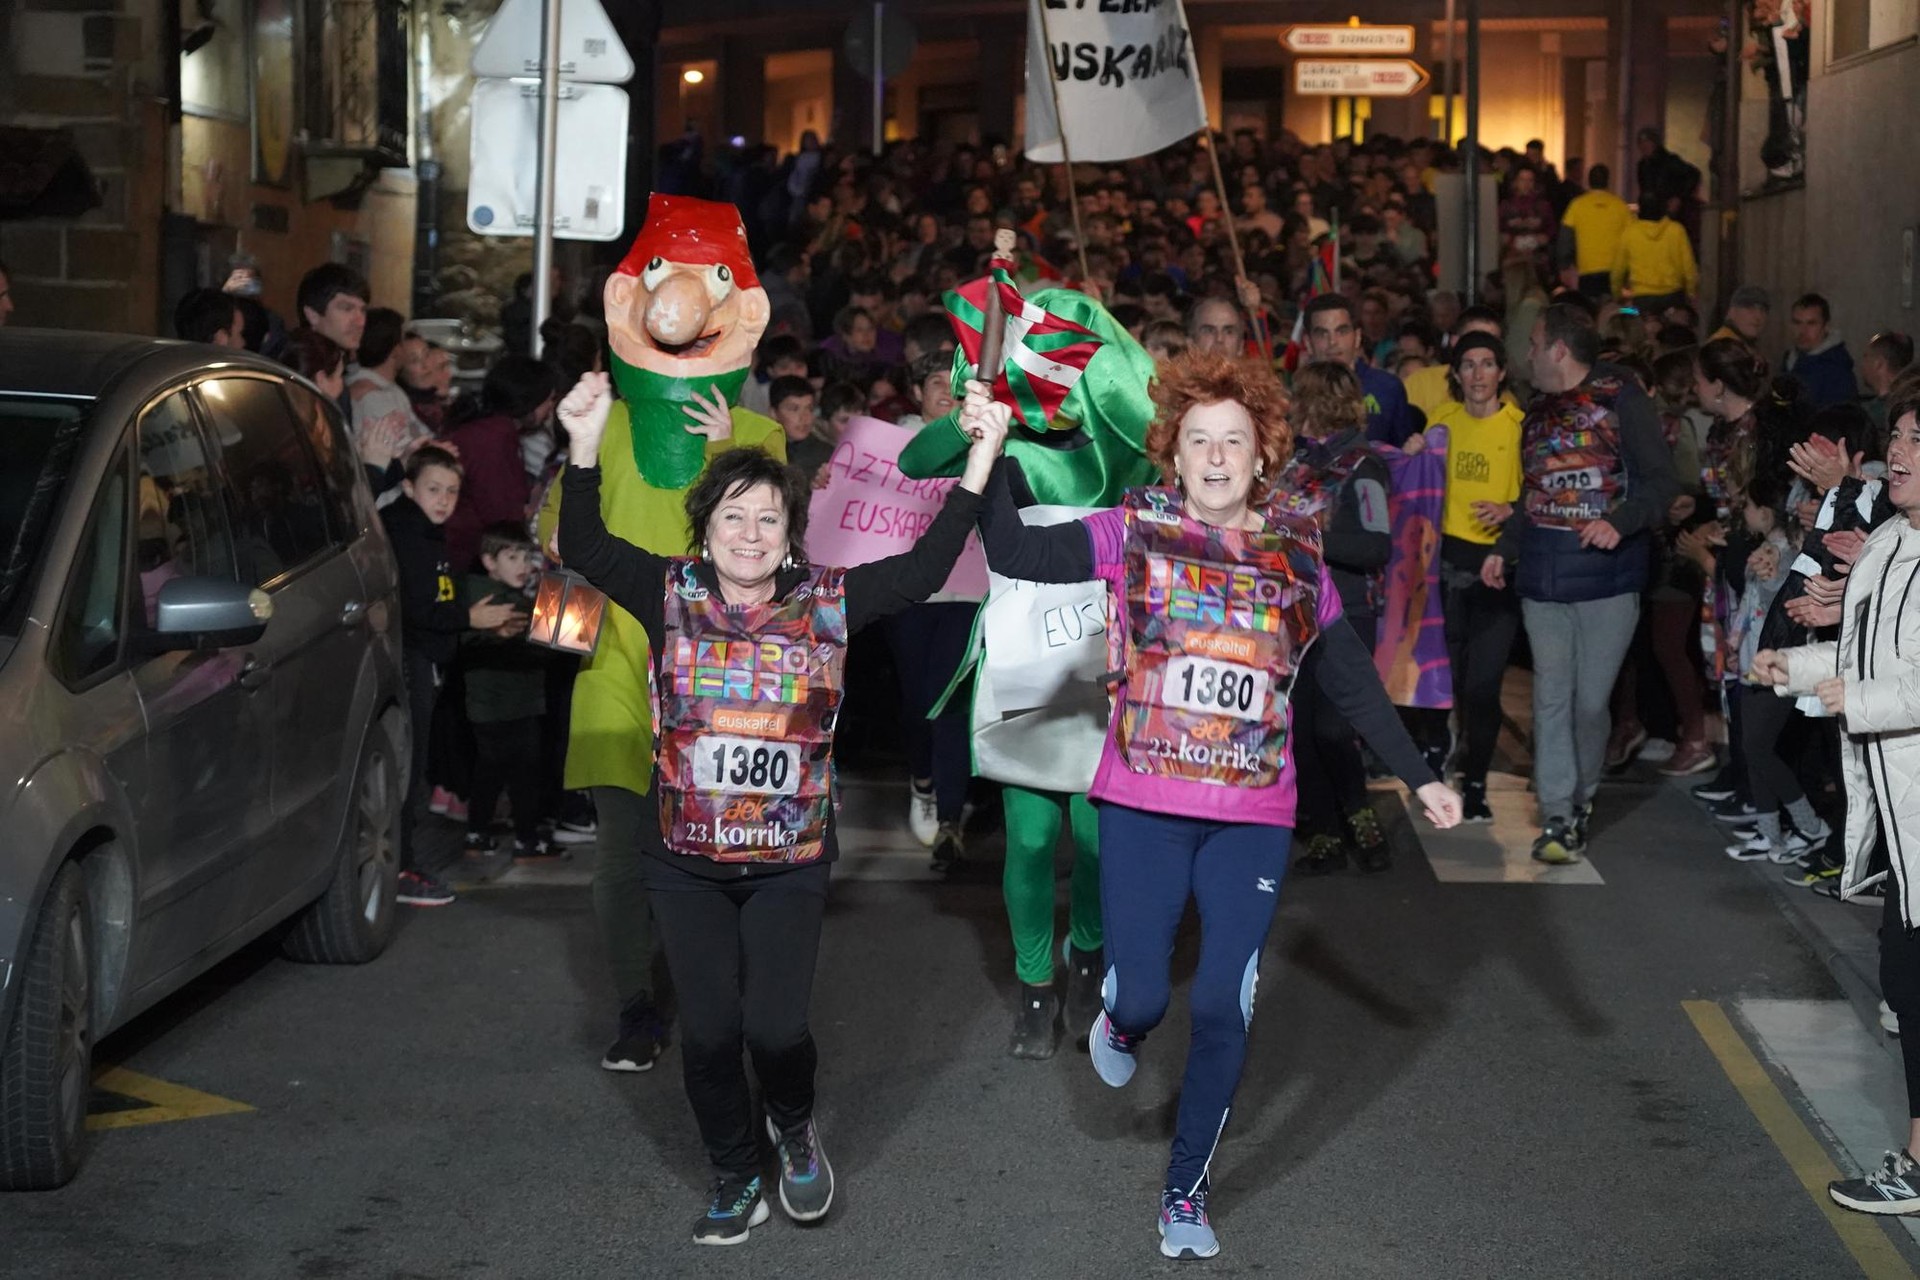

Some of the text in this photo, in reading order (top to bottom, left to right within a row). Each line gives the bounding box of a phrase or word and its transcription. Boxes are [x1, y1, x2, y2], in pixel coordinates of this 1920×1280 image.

[829, 441, 960, 502] AZTERK
[840, 500, 933, 540] EUSKAR
[1189, 637, 1250, 657] euskaltel
[1181, 664, 1254, 712] 1380
[718, 716, 780, 731] euskaltel
[1191, 718, 1234, 742] aek
[712, 744, 789, 789] 1380
[724, 796, 768, 822] aek
